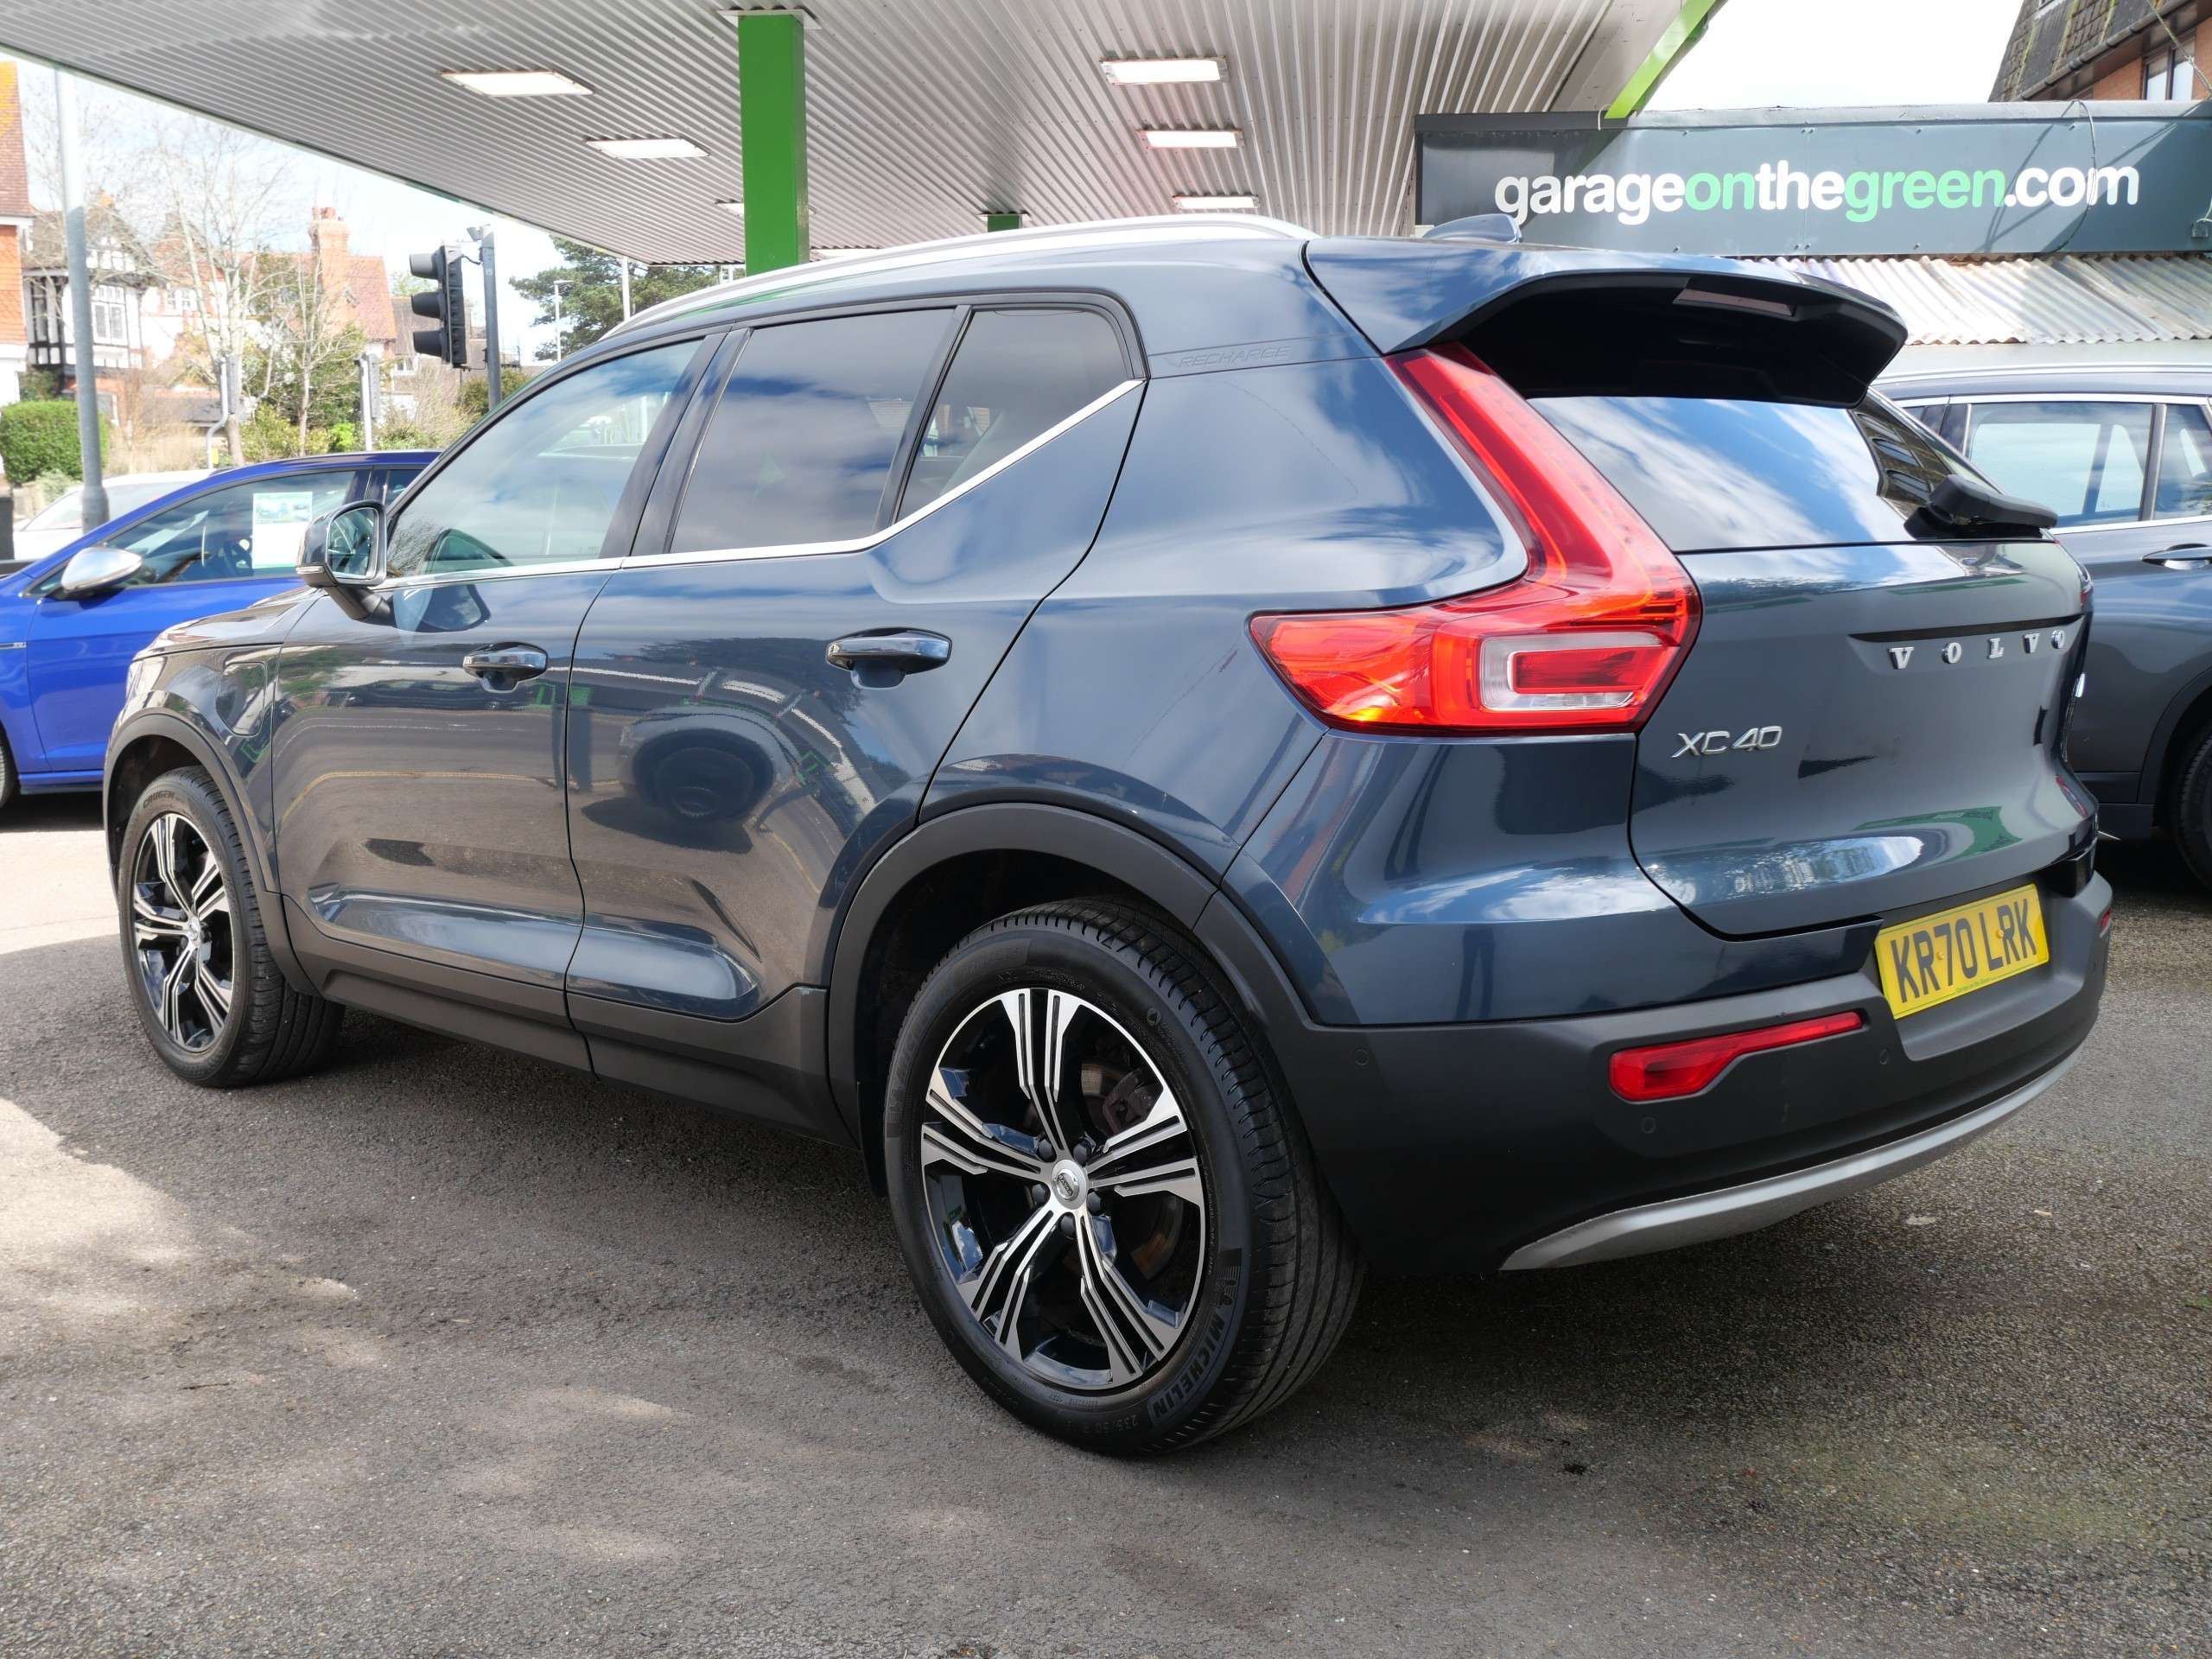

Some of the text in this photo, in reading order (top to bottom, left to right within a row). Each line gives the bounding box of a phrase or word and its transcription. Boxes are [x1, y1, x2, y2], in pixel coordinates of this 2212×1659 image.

[1495, 159, 2139, 226] garageonthegreen.com
[1178, 346, 1291, 368] RECHARGE
[1888, 629, 2066, 670] VOLVO
[1671, 725, 1783, 758] XC40
[1890, 898, 2037, 1003] KR70 LRK
[1151, 1313, 1226, 1419] MICHELIN
